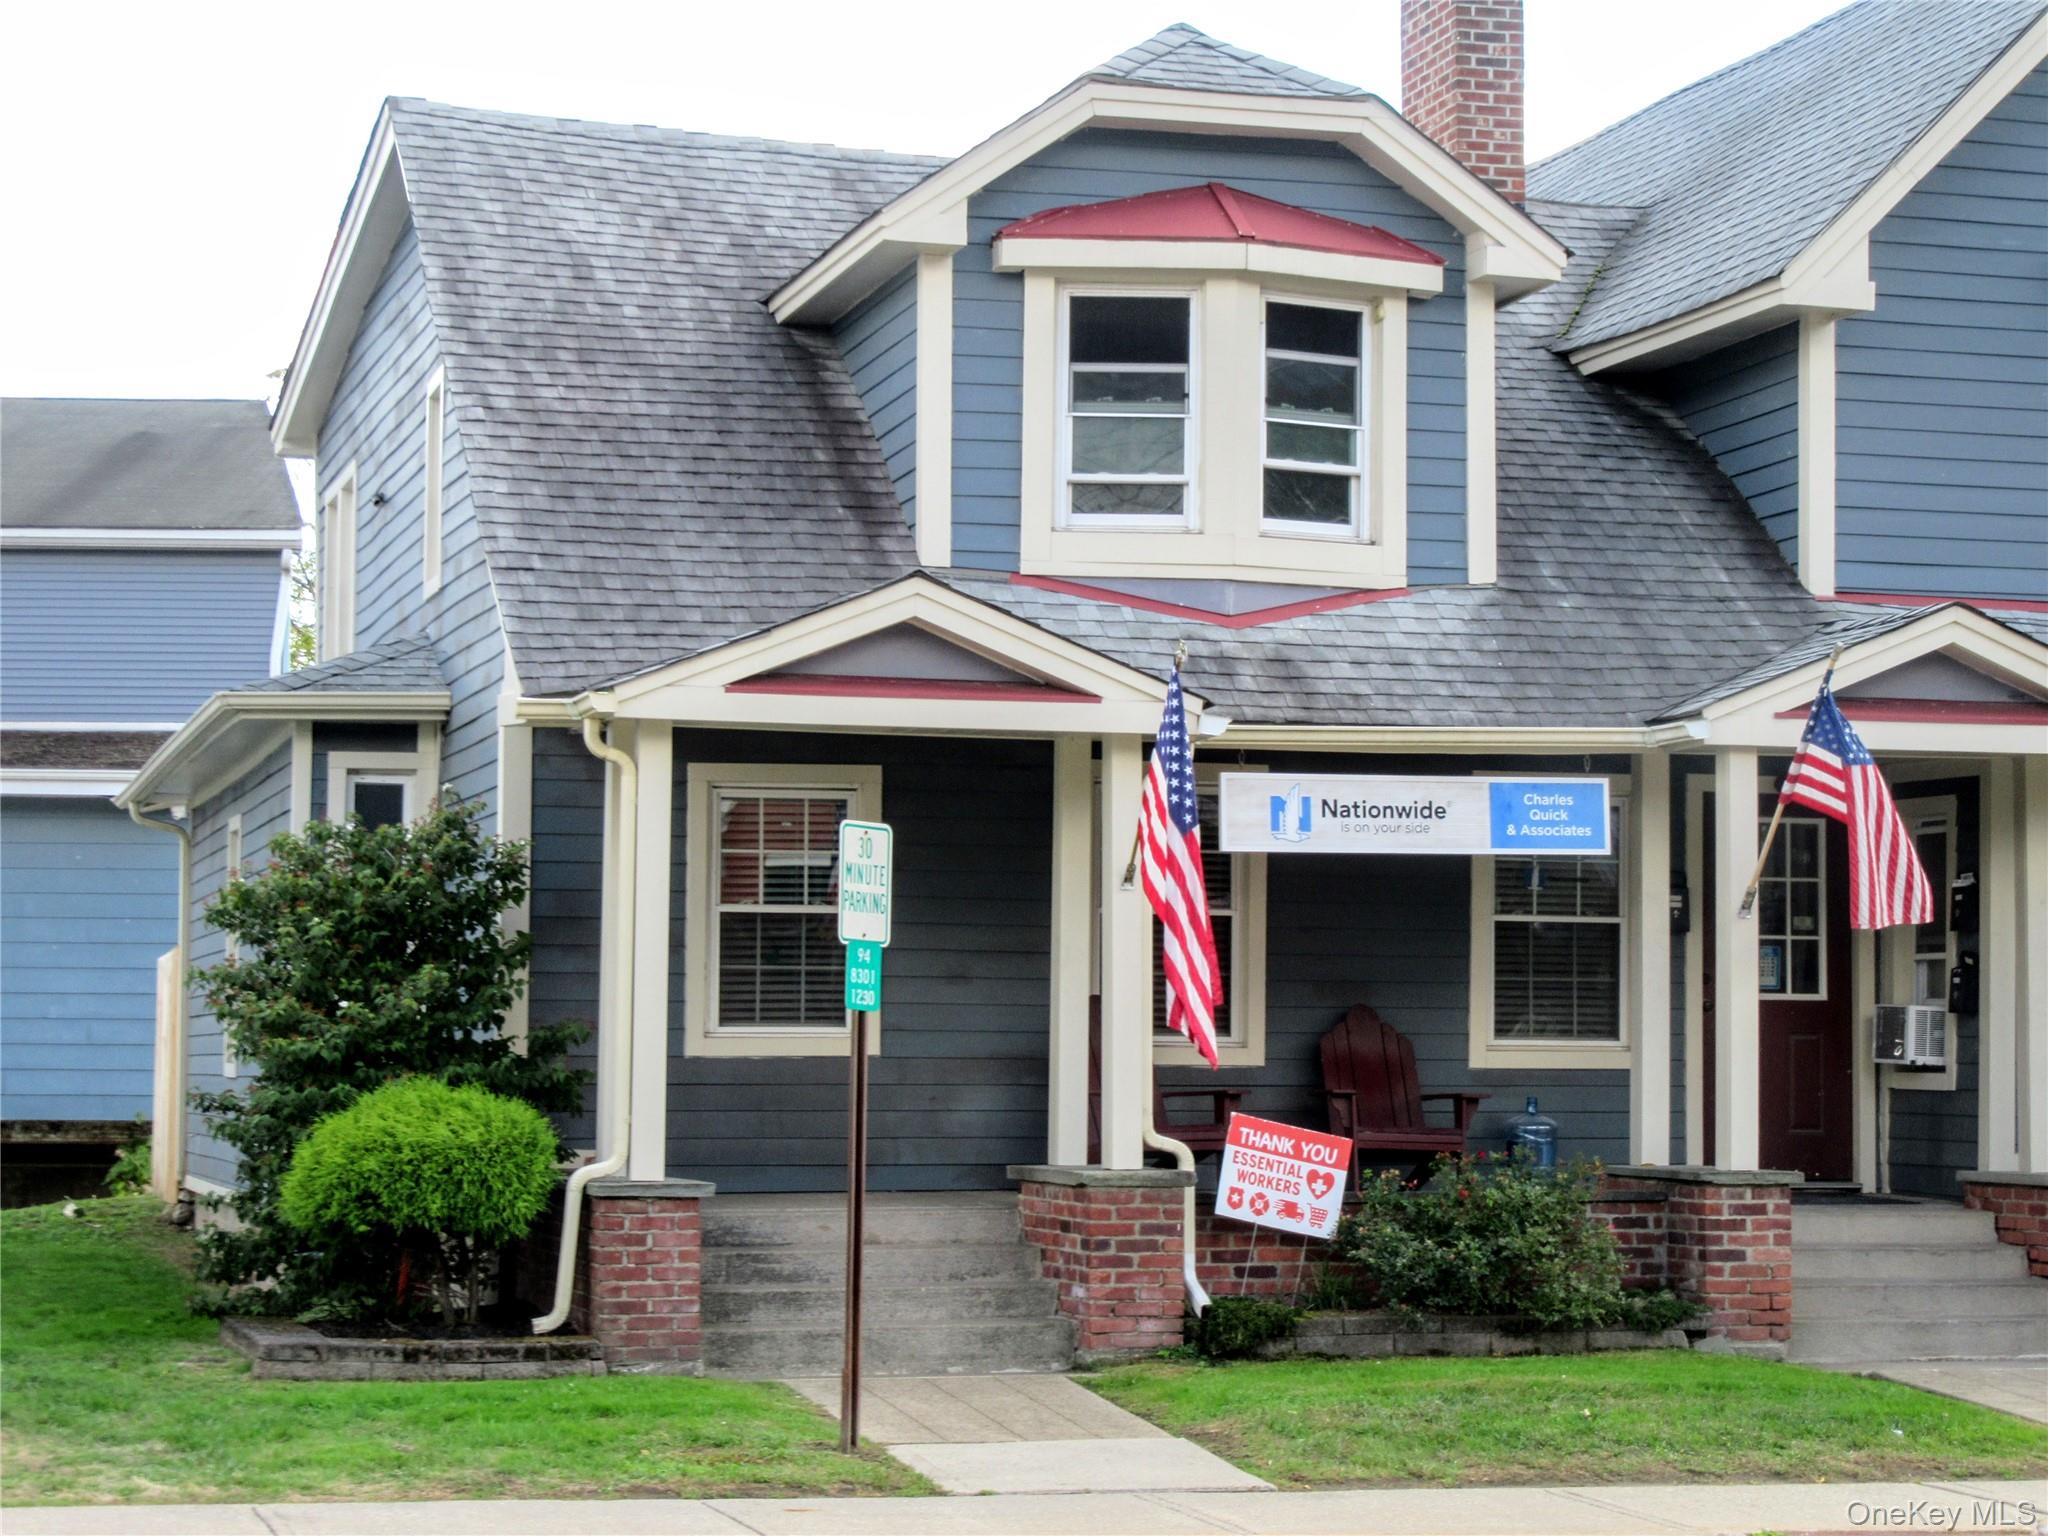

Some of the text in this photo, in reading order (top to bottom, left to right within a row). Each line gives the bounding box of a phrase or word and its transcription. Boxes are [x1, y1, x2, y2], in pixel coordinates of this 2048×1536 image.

[1523, 794, 1574, 806] Charles
[1529, 809, 1569, 821] Quick
[1341, 822, 1431, 835] is on your side
[1506, 824, 1593, 837] & Associates
[858, 837, 873, 859] 30
[845, 862, 886, 887] MINUTE
[843, 890, 887, 914] PARKING
[857, 947, 871, 964] 94
[850, 968, 875, 985] 8301
[851, 989, 875, 1005] 1230
[1239, 1127, 1338, 1164] THANK YOU
[1232, 1150, 1304, 1179] ESSENTIAL
[1237, 1168, 1301, 1196] WORKERS
